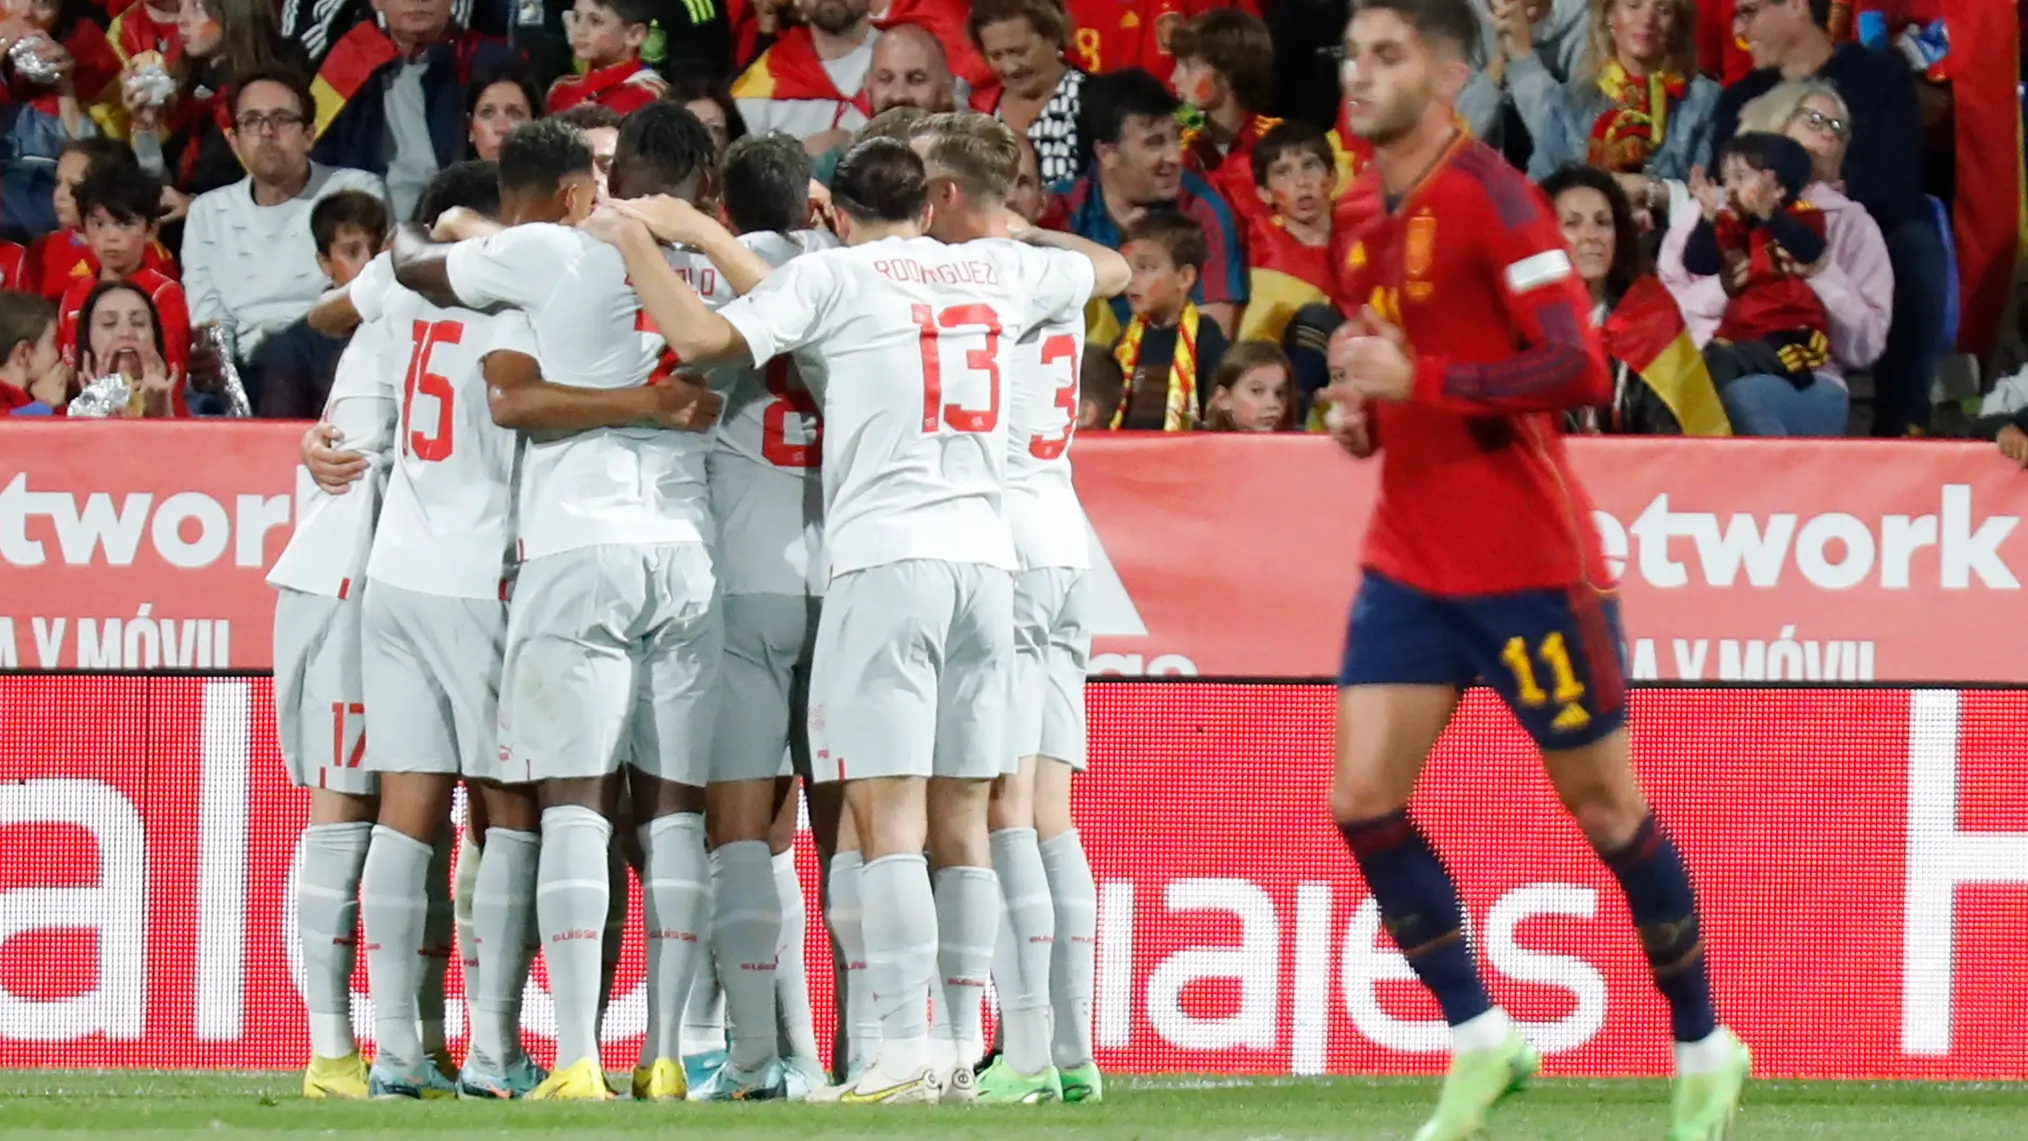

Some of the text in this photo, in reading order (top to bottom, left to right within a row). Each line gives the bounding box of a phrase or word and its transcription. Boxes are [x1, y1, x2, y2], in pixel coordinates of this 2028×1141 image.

[402, 318, 464, 462] 15
[911, 302, 1002, 433] 13
[1029, 335, 1078, 460] 3
[0, 464, 318, 568] twor
[1502, 631, 1585, 706] 11
